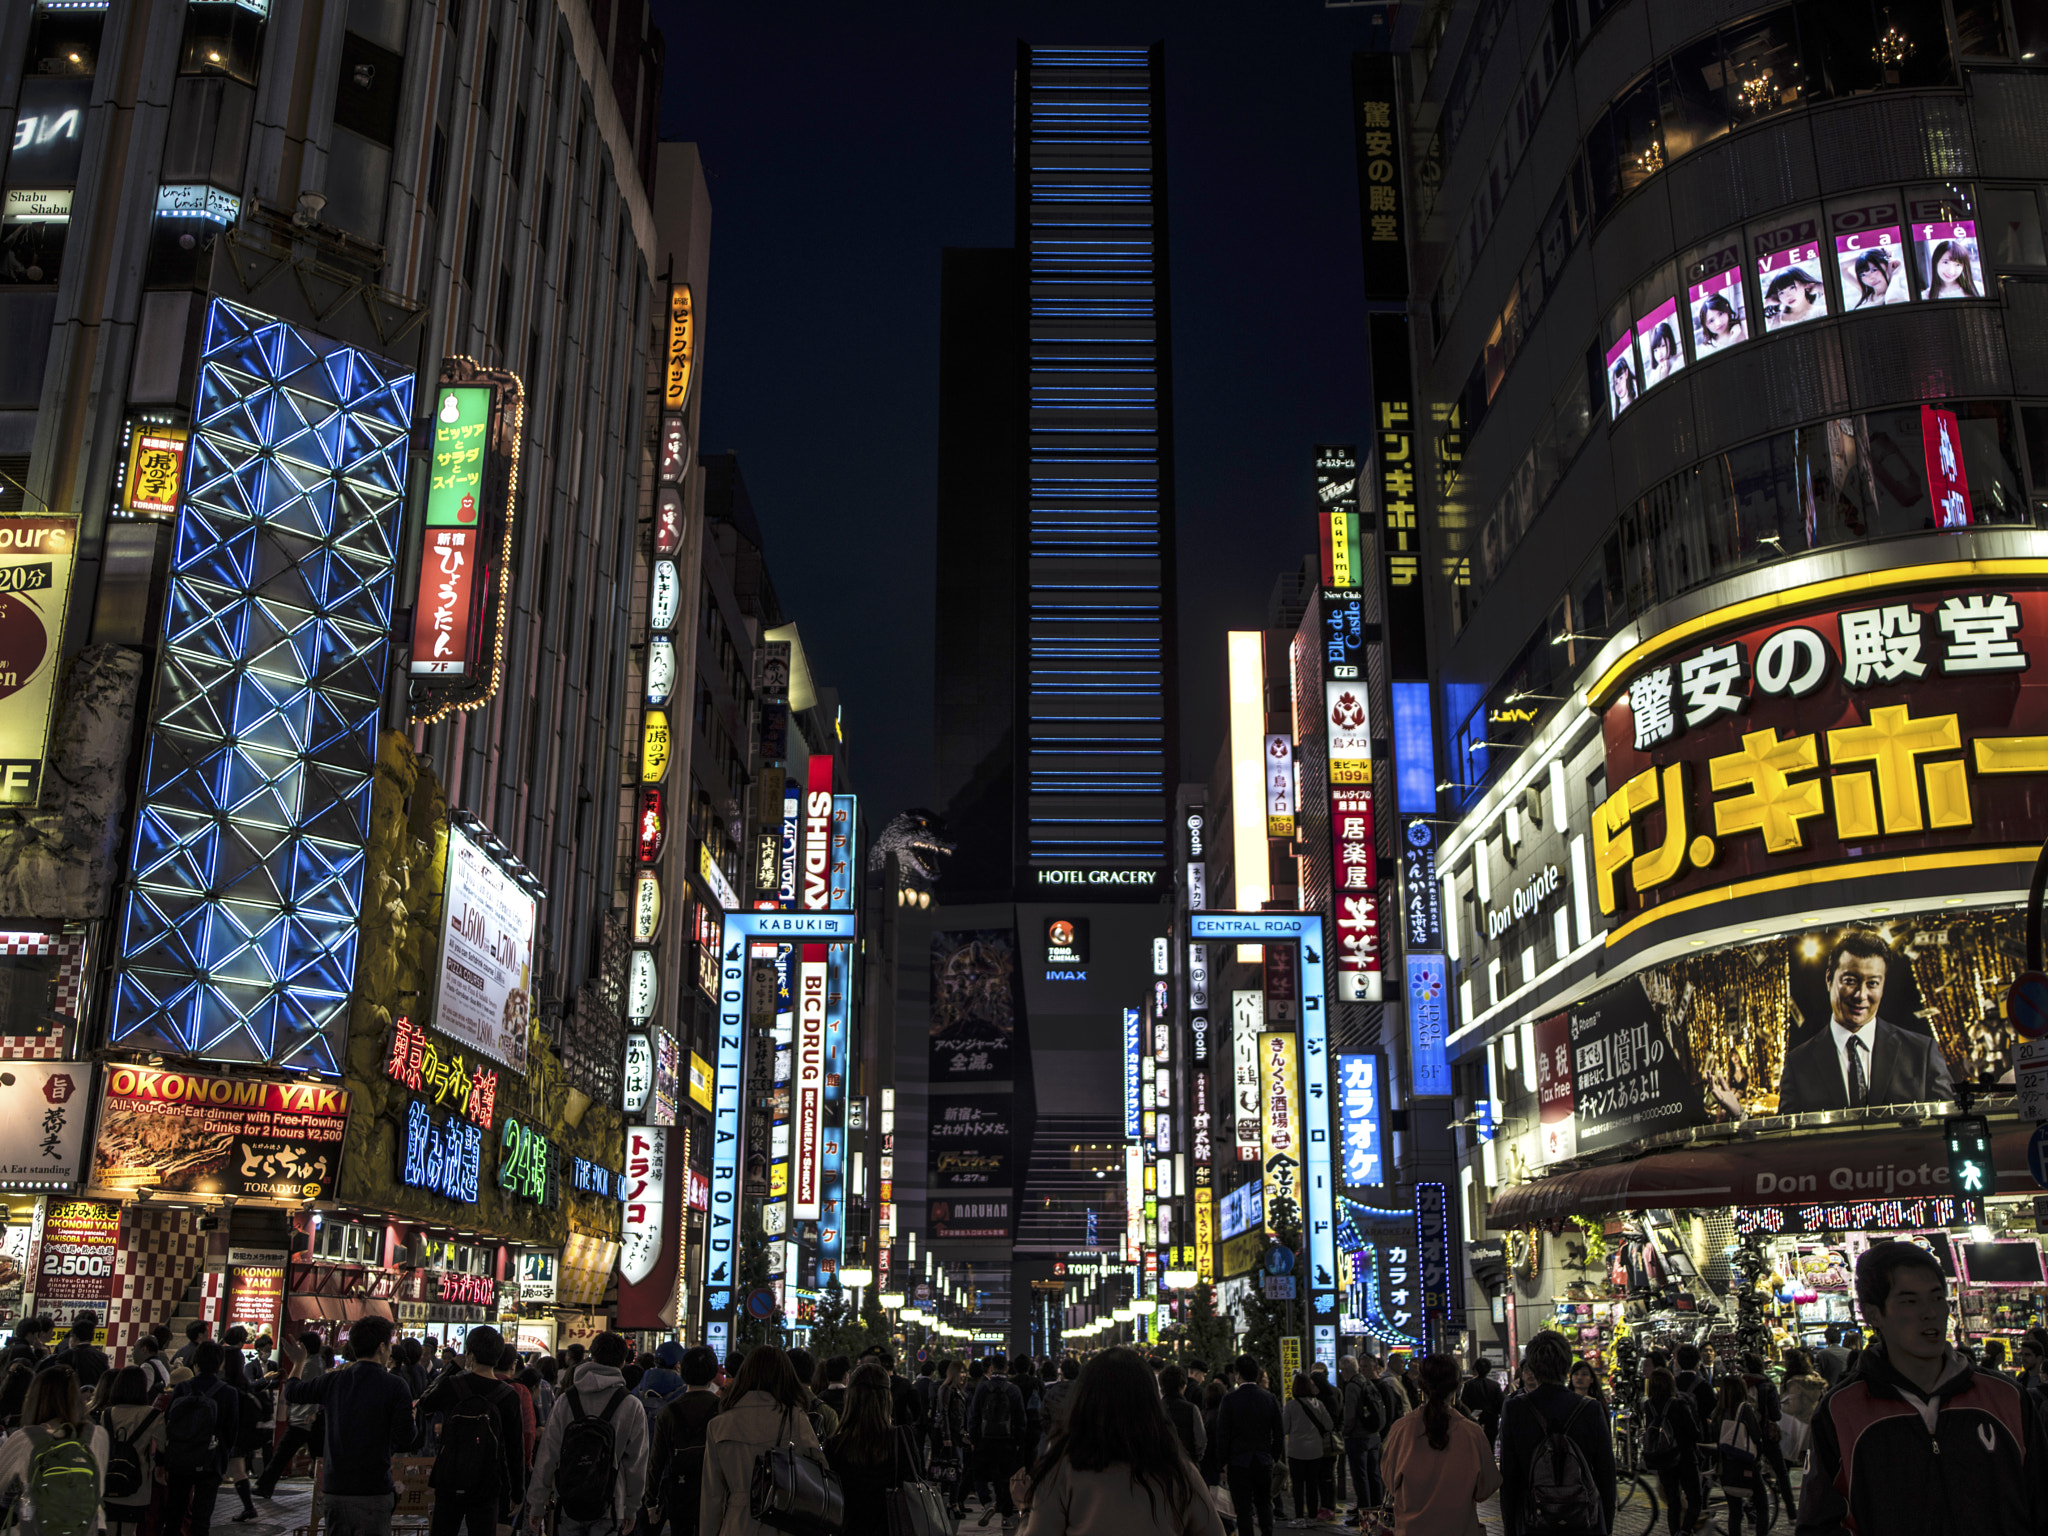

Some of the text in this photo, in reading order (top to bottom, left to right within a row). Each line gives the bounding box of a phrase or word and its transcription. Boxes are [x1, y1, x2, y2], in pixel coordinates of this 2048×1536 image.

[1363, 101, 1398, 241] 驚安の殿堂
[9, 191, 47, 202] Shabu
[29, 203, 68, 214] Shabu
[137, 425, 161, 436] 4F
[455, 440, 465, 450] と
[437, 448, 480, 467] サラダ
[144, 454, 172, 494] 虎の子
[452, 465, 462, 474] と
[433, 473, 479, 490] スイーツ
[437, 533, 465, 545] 新宿
[1334, 515, 1348, 571] Garum
[433, 545, 465, 659] ひょうたん
[1324, 590, 1361, 599] New Club
[1327, 609, 1346, 663] Elle de
[1345, 600, 1362, 649] Castle
[430, 662, 449, 672] 7F
[1338, 667, 1355, 676] 7F
[1628, 594, 2028, 751] 驚安の殿堂
[647, 731, 667, 766] 虎の子
[1187, 814, 1204, 856] Booth
[832, 809, 848, 901] カラオケ
[1342, 817, 1368, 888] 居楽屋
[1039, 870, 1157, 884] HOTEL GRACERY
[639, 881, 654, 936] お好み焼き
[1488, 864, 1559, 941] Don Quijote
[461, 902, 486, 949] 1,600
[1197, 920, 1302, 932] CENTRAL ROAD
[1338, 896, 1378, 968] 笑笑
[495, 929, 517, 973] 1,700
[1048, 954, 1080, 962] CINEMAS
[447, 958, 484, 991] PIZZA COURSE
[1046, 971, 1087, 981] IMAX
[631, 1017, 645, 1027] 1F
[802, 975, 822, 1081] BIC DRUG
[1418, 1003, 1430, 1051] STAGE
[1429, 1004, 1441, 1044] IDOL
[629, 1039, 646, 1048] 新宿
[1192, 1017, 1208, 1060] Booth
[1421, 1065, 1442, 1079] 5F
[1539, 1043, 1569, 1084] 免税
[111, 1070, 349, 1114] OKONOMI YAKI
[1270, 1037, 1288, 1129] きんくら酒場
[1540, 1081, 1571, 1104] Tax Free
[628, 1097, 642, 1106] B1
[712, 968, 742, 1252] GODZILLA ROAD
[803, 1090, 814, 1110] BIC
[207, 1107, 245, 1122] dinner
[247, 1111, 270, 1124] with
[273, 1113, 344, 1131] Free-Flowing
[1304, 993, 1329, 1234] ゴジラロード
[1344, 1057, 1379, 1181] カラオケ
[39, 1107, 67, 1160] 蕎麦
[204, 1121, 342, 1143] Drinks for 2 hours ¥2,500
[1194, 1112, 1212, 1162] 甘太郎
[252, 1142, 282, 1151] お好み焼き
[404, 1099, 482, 1205] 飲み放題
[650, 1128, 664, 1181] 大衆酒場
[10, 1165, 71, 1176] Eat standing
[108, 1167, 156, 1176] kinds drinks
[141, 1177, 160, 1185] foods
[627, 1135, 650, 1224] トラノコ
[1195, 1167, 1211, 1176] 4F
[1196, 1177, 1211, 1185] 3F
[1756, 1163, 1952, 1200] Don Quijote
[244, 1182, 319, 1196] TORADYU 2F
[49, 1202, 120, 1221] お好み焼き
[821, 1139, 839, 1274] カラオケ館
[954, 1204, 1008, 1218] MARUHAN
[47, 1219, 118, 1231] OKONOMI YAKI
[46, 1234, 117, 1244] YAKISOBA MONJYA
[1421, 1187, 1446, 1287] カラオケ
[233, 1266, 284, 1278] OKONOMI
[245, 1277, 272, 1288] YAKI
[520, 1288, 555, 1299] 虎の子
[1388, 1246, 1412, 1327] カラオケ
[1425, 1292, 1445, 1307] B1
